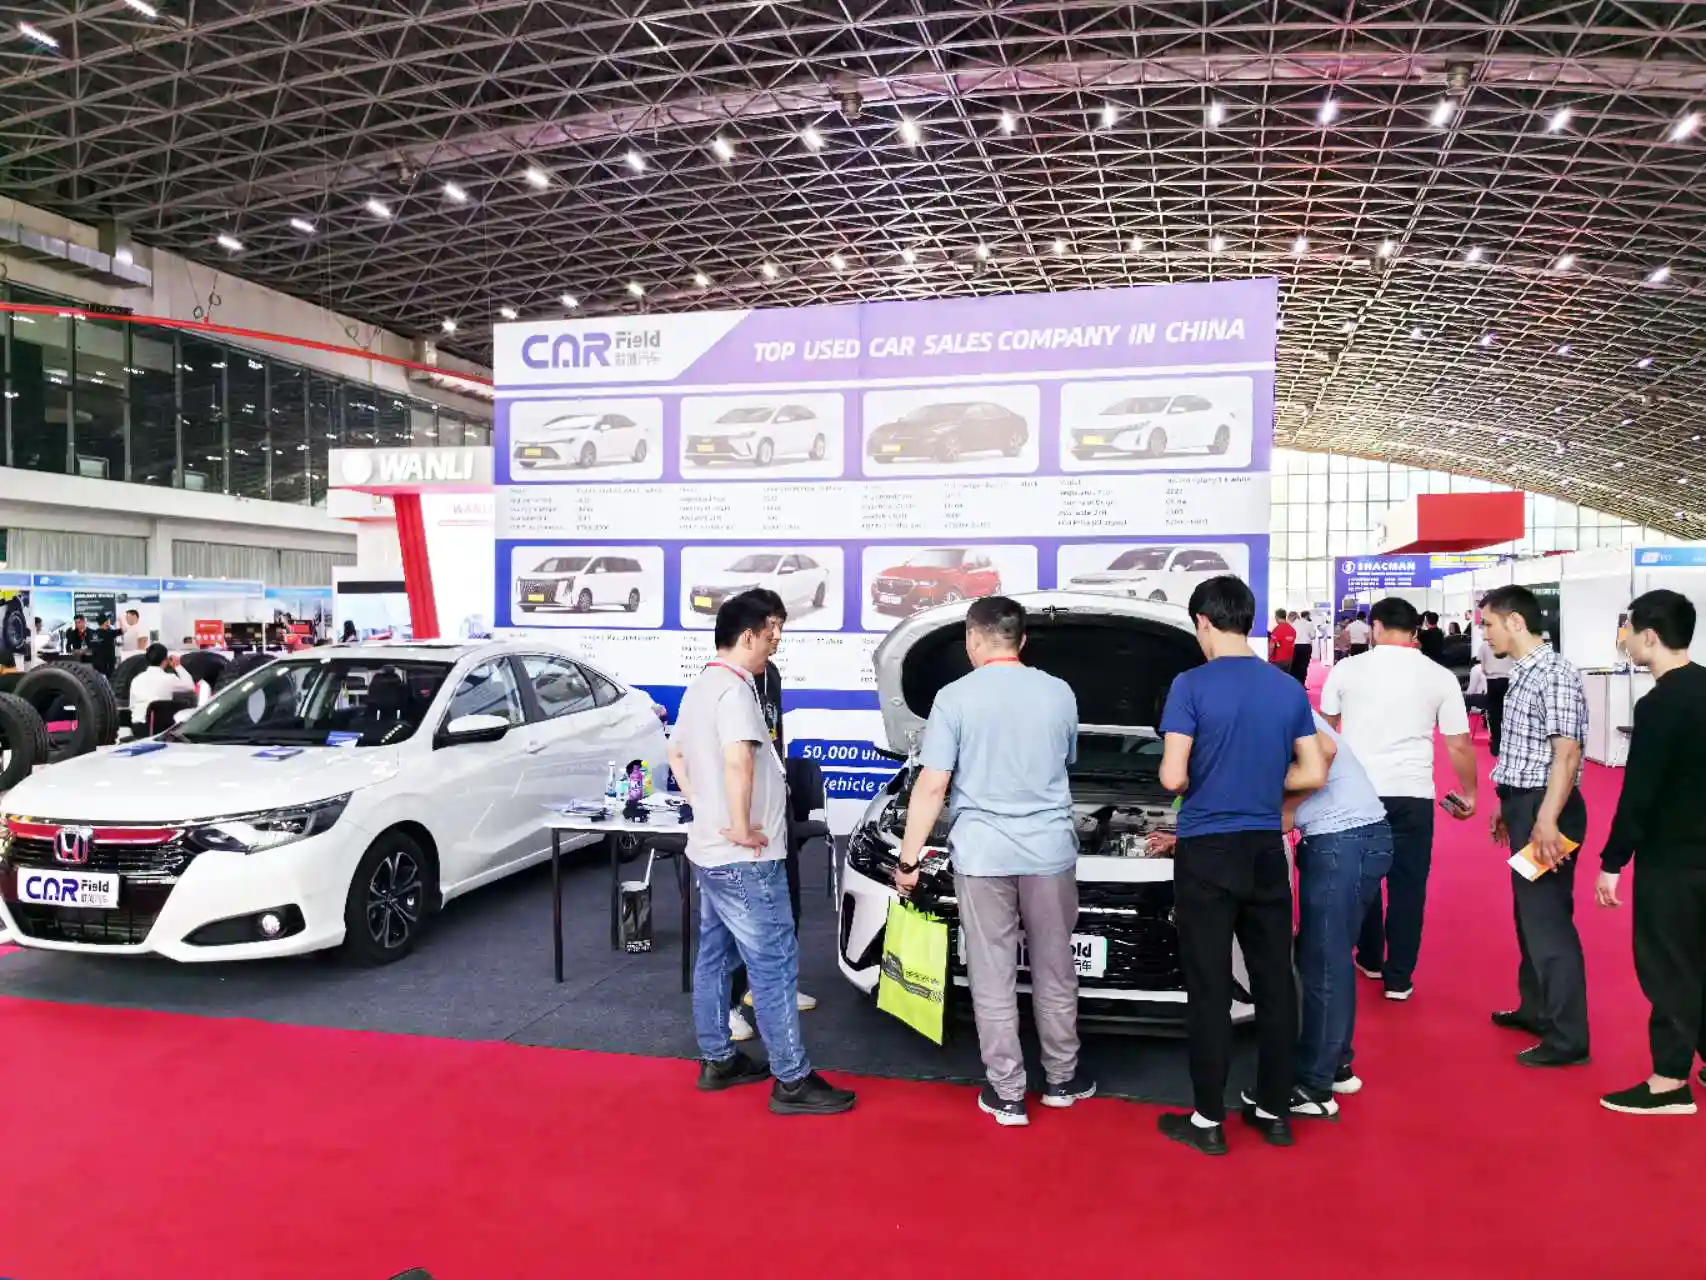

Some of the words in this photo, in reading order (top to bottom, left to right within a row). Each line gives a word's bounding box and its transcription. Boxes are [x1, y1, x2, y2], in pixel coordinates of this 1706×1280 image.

[521, 333, 611, 369] CAR
[615, 330, 661, 349] Field
[754, 341, 796, 362] TOP
[803, 339, 861, 361] USED
[869, 336, 916, 358] CAR
[922, 332, 993, 355] SALES
[998, 324, 1121, 351] COMPANY
[1128, 323, 1156, 345] IN
[1165, 318, 1245, 342] CHINA
[379, 451, 474, 481] WANLI
[802, 745, 858, 760] 50,000
[26, 876, 79, 902] CAR
[81, 880, 109, 893] Field
